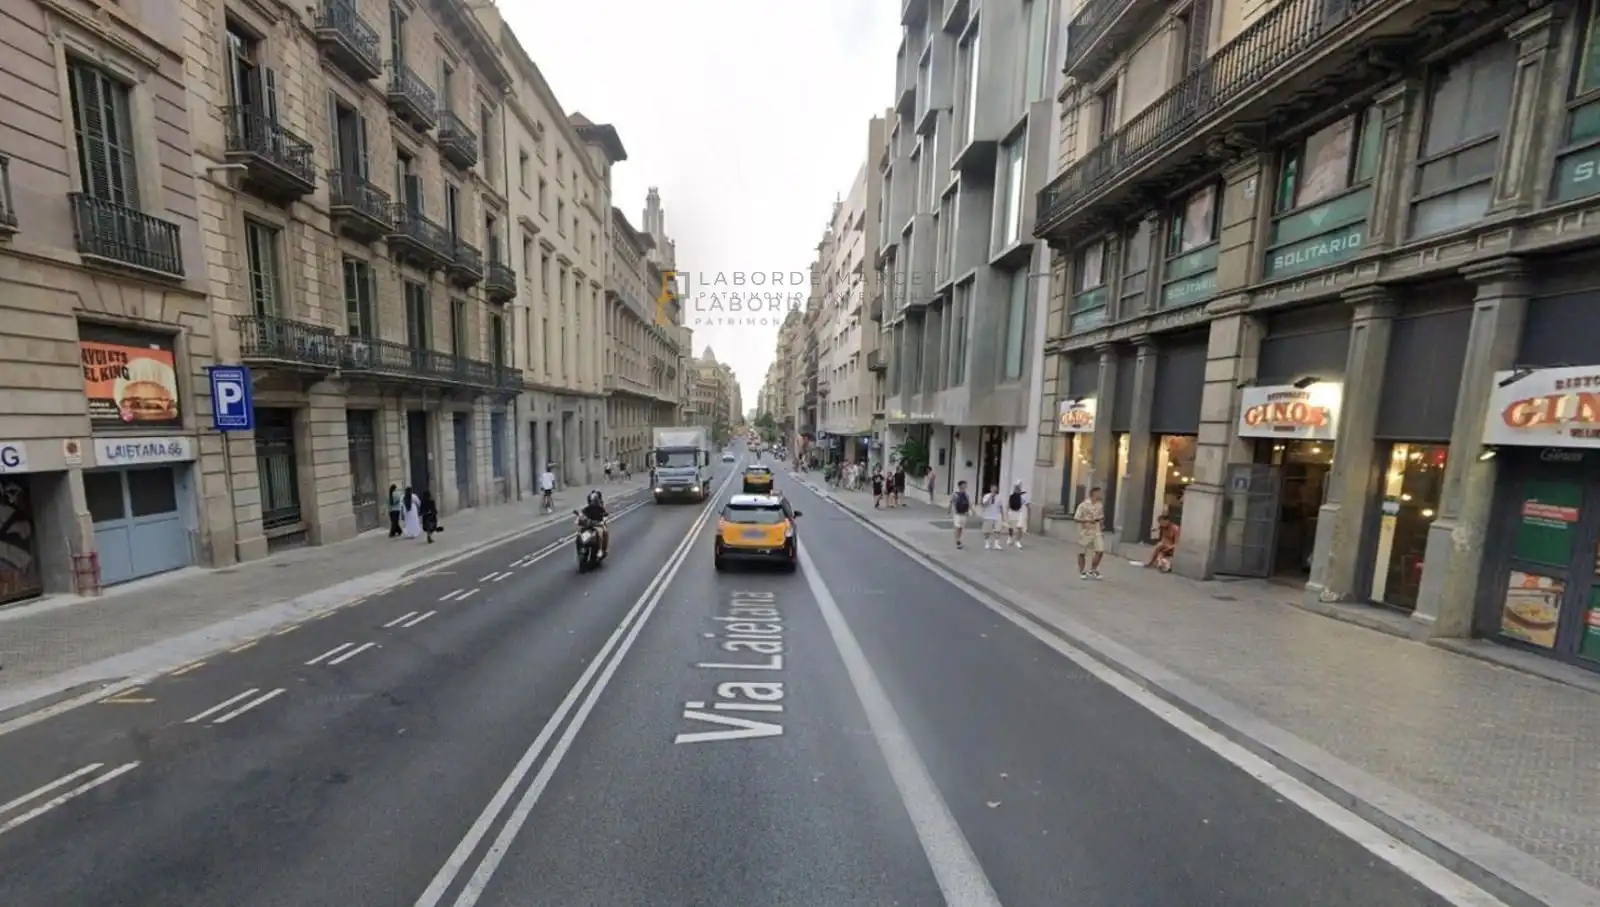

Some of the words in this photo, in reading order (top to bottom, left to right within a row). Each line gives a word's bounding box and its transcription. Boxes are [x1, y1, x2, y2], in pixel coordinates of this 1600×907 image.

[1273, 232, 1361, 270] SOLITARIO
[100, 364, 131, 382] KING
[217, 382, 242, 415] P
[105, 442, 166, 459] LAIETANA
[695, 591, 784, 670] Laietana
[674, 682, 784, 744] Via
